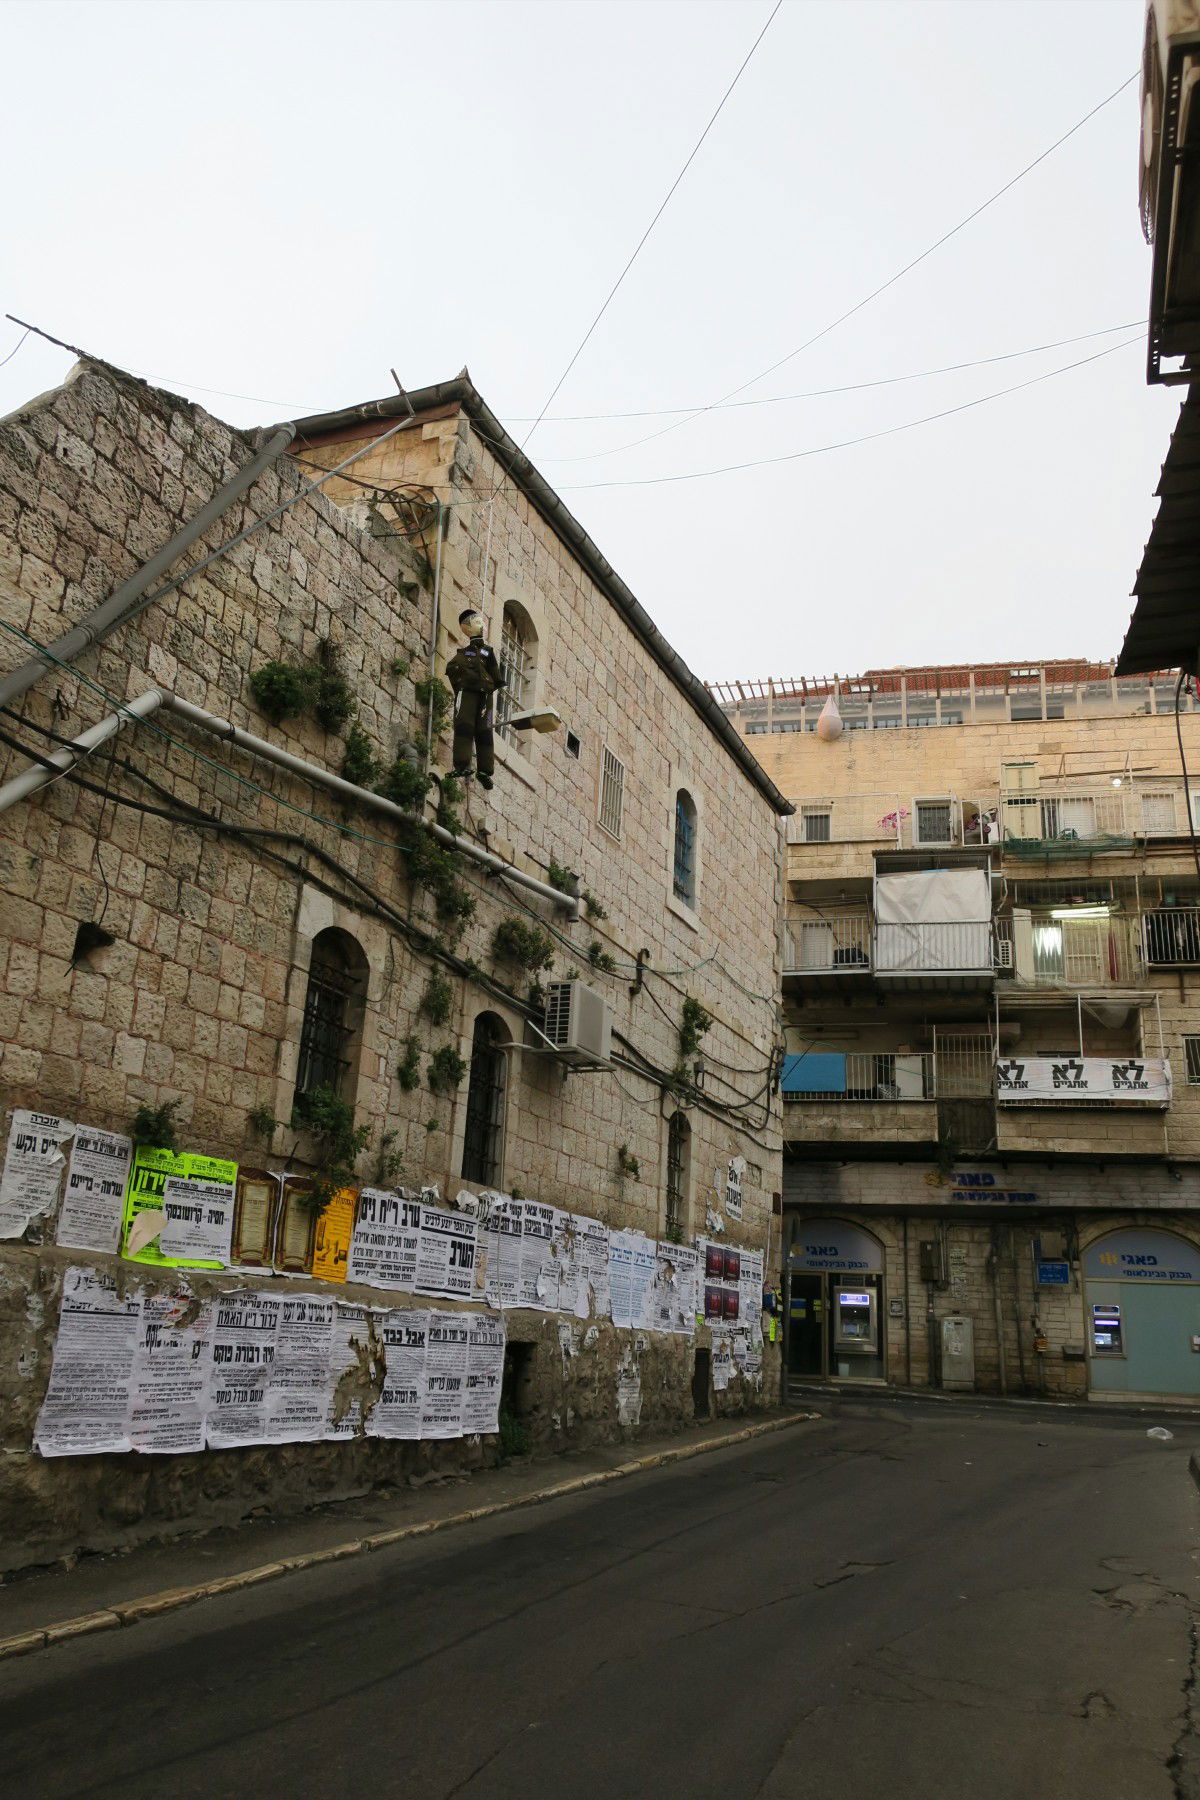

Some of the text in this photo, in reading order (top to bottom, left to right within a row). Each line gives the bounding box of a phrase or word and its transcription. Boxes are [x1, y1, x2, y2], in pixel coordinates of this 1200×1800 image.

[997, 1060, 1025, 1080] לא
[1052, 1059, 1084, 1080] לא
[1112, 1060, 1144, 1081] לא
[31, 1114, 60, 1126] אזכרה
[402, 1203, 421, 1228] ערב
[424, 1214, 440, 1226] לרבים
[539, 1207, 554, 1223] קומי
[449, 1240, 475, 1269] הערב
[806, 1245, 839, 1256] פאגי
[806, 1259, 869, 1269] הבנק הבינלאומי
[1120, 1254, 1158, 1266] פאגי
[1122, 1268, 1193, 1280] הבנק הבינלאומי
[261, 1313, 277, 1327] ברוך
[383, 1328, 426, 1345] אבל כבד
